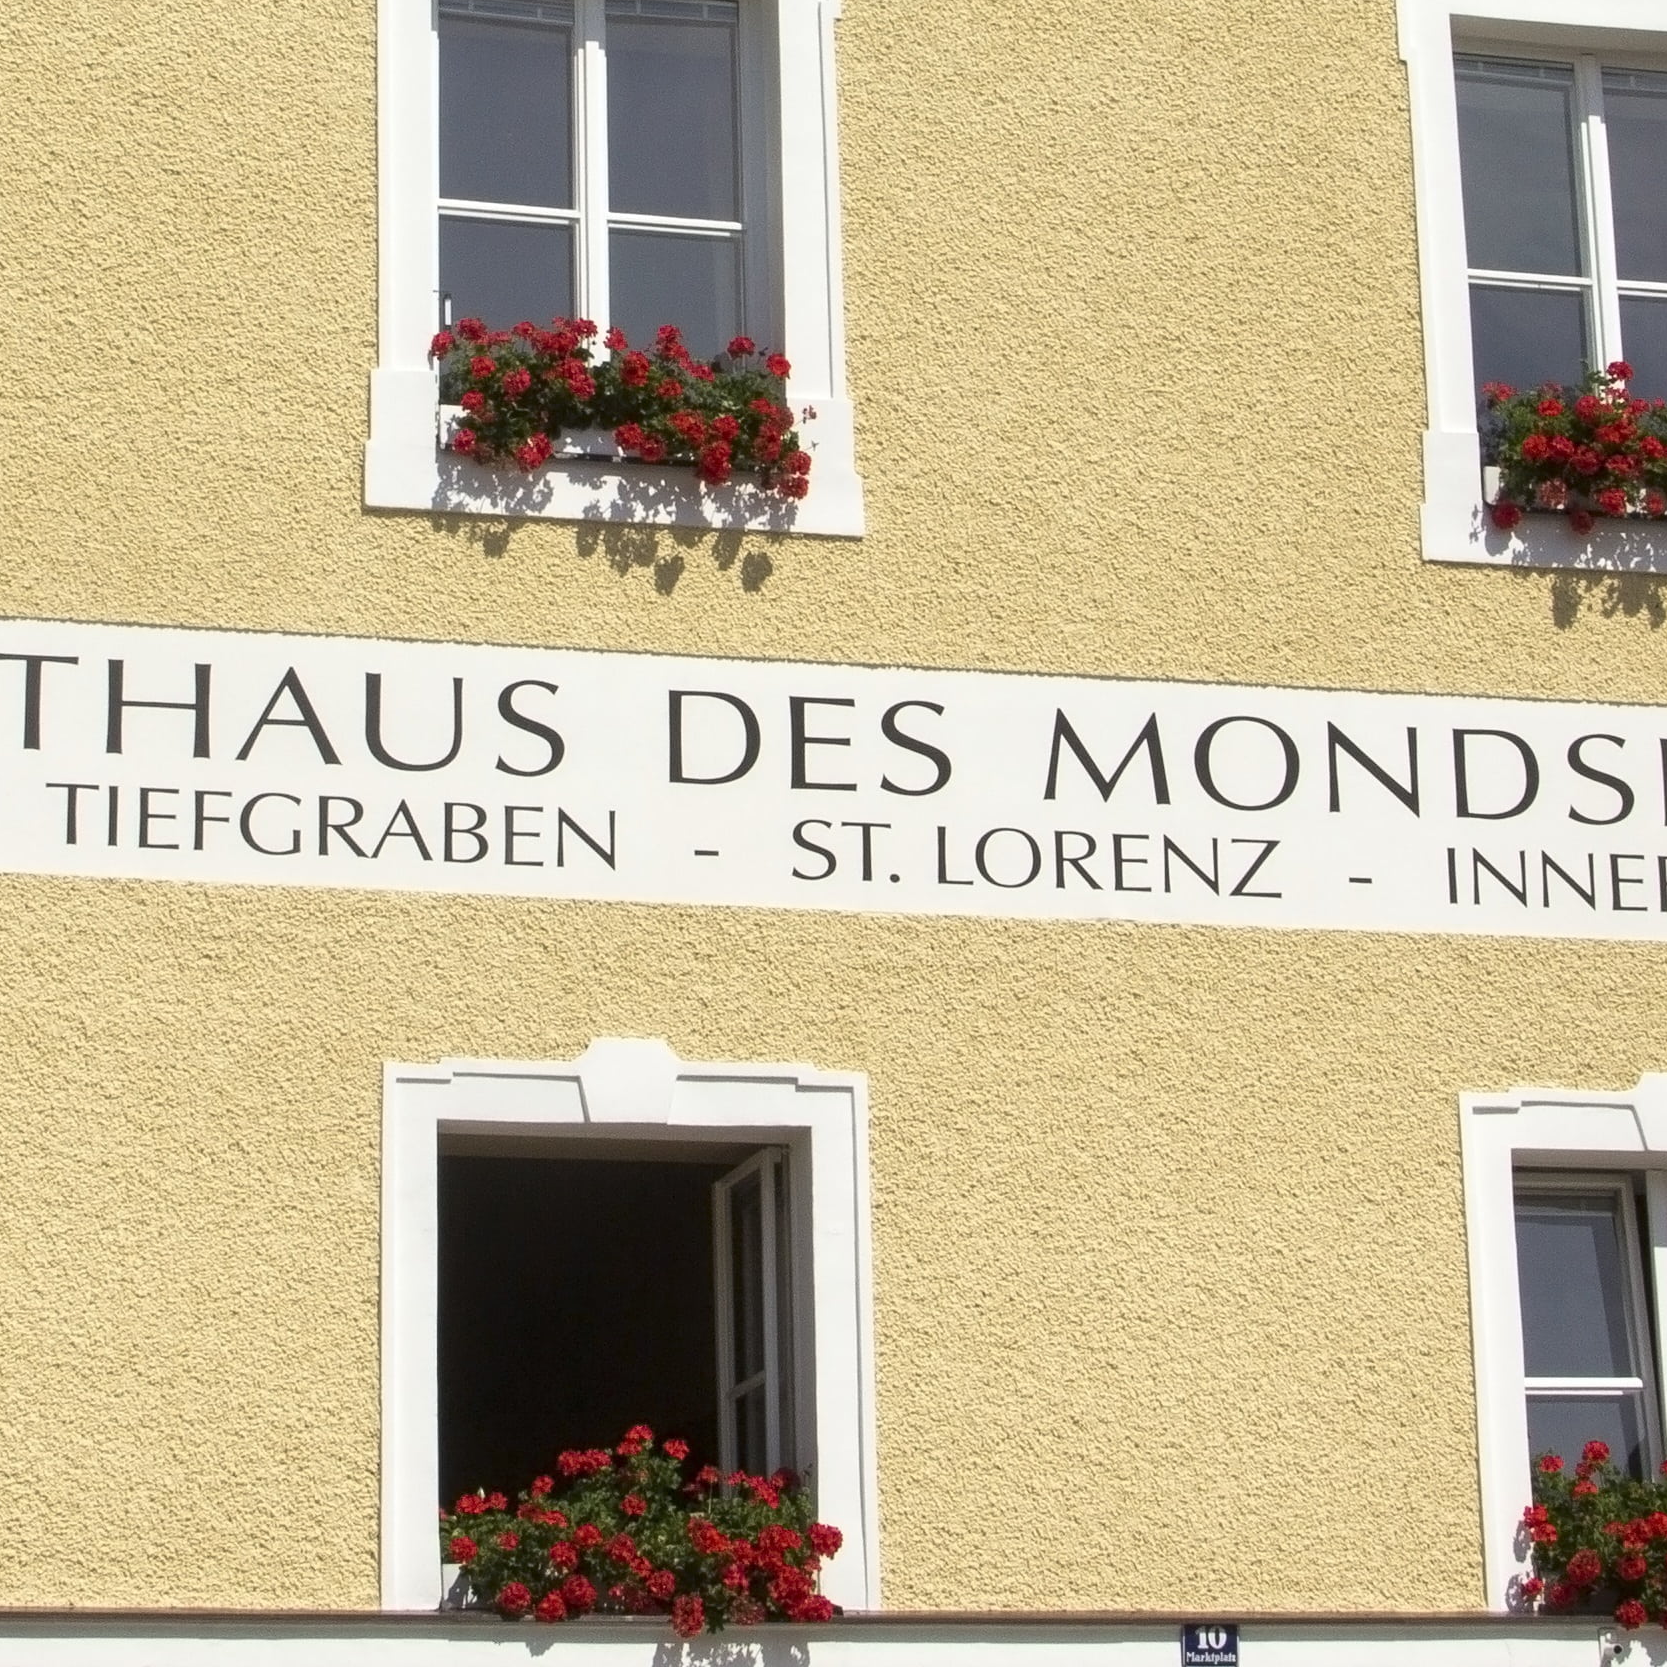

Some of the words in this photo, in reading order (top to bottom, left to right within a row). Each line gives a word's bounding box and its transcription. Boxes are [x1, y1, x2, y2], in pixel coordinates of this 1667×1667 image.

[667, 689, 952, 797] DES
[45, 782, 616, 870] TIEFGRABEN
[1186, 1651, 1237, 1665] Marktplatz
[1195, 1625, 1227, 1649] 10
